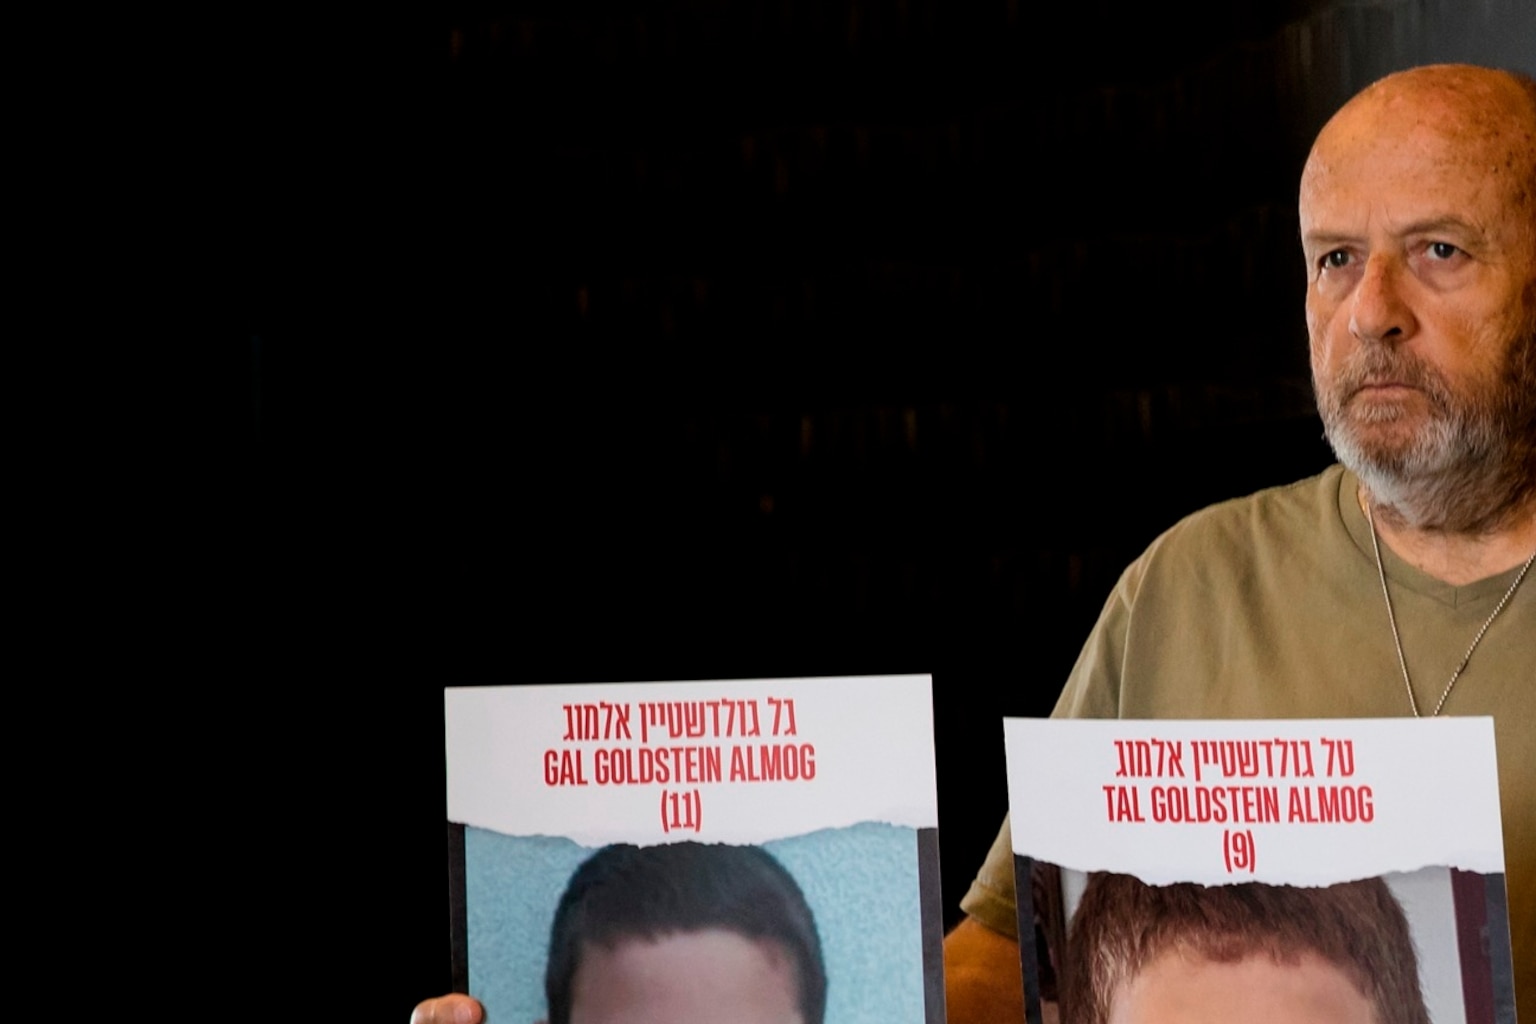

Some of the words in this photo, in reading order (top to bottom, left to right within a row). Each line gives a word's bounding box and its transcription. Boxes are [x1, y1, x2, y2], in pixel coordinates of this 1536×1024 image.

[563, 701, 632, 741] אלמוג
[639, 698, 760, 743] גולדשטיין
[767, 696, 797, 736] גל
[544, 749, 588, 786] GAL
[594, 746, 723, 785] GOLDSTEIN
[729, 743, 816, 783] ALMOG
[1114, 738, 1185, 778] אלמוג
[1190, 737, 1315, 781] גולדשטיין
[1320, 737, 1354, 777] טל
[660, 790, 702, 833] (11)
[1103, 785, 1145, 823] TAL
[1151, 785, 1280, 823] GOLDSTEIN
[1287, 785, 1374, 823] ALMOG
[1222, 829, 1256, 873] (9)
